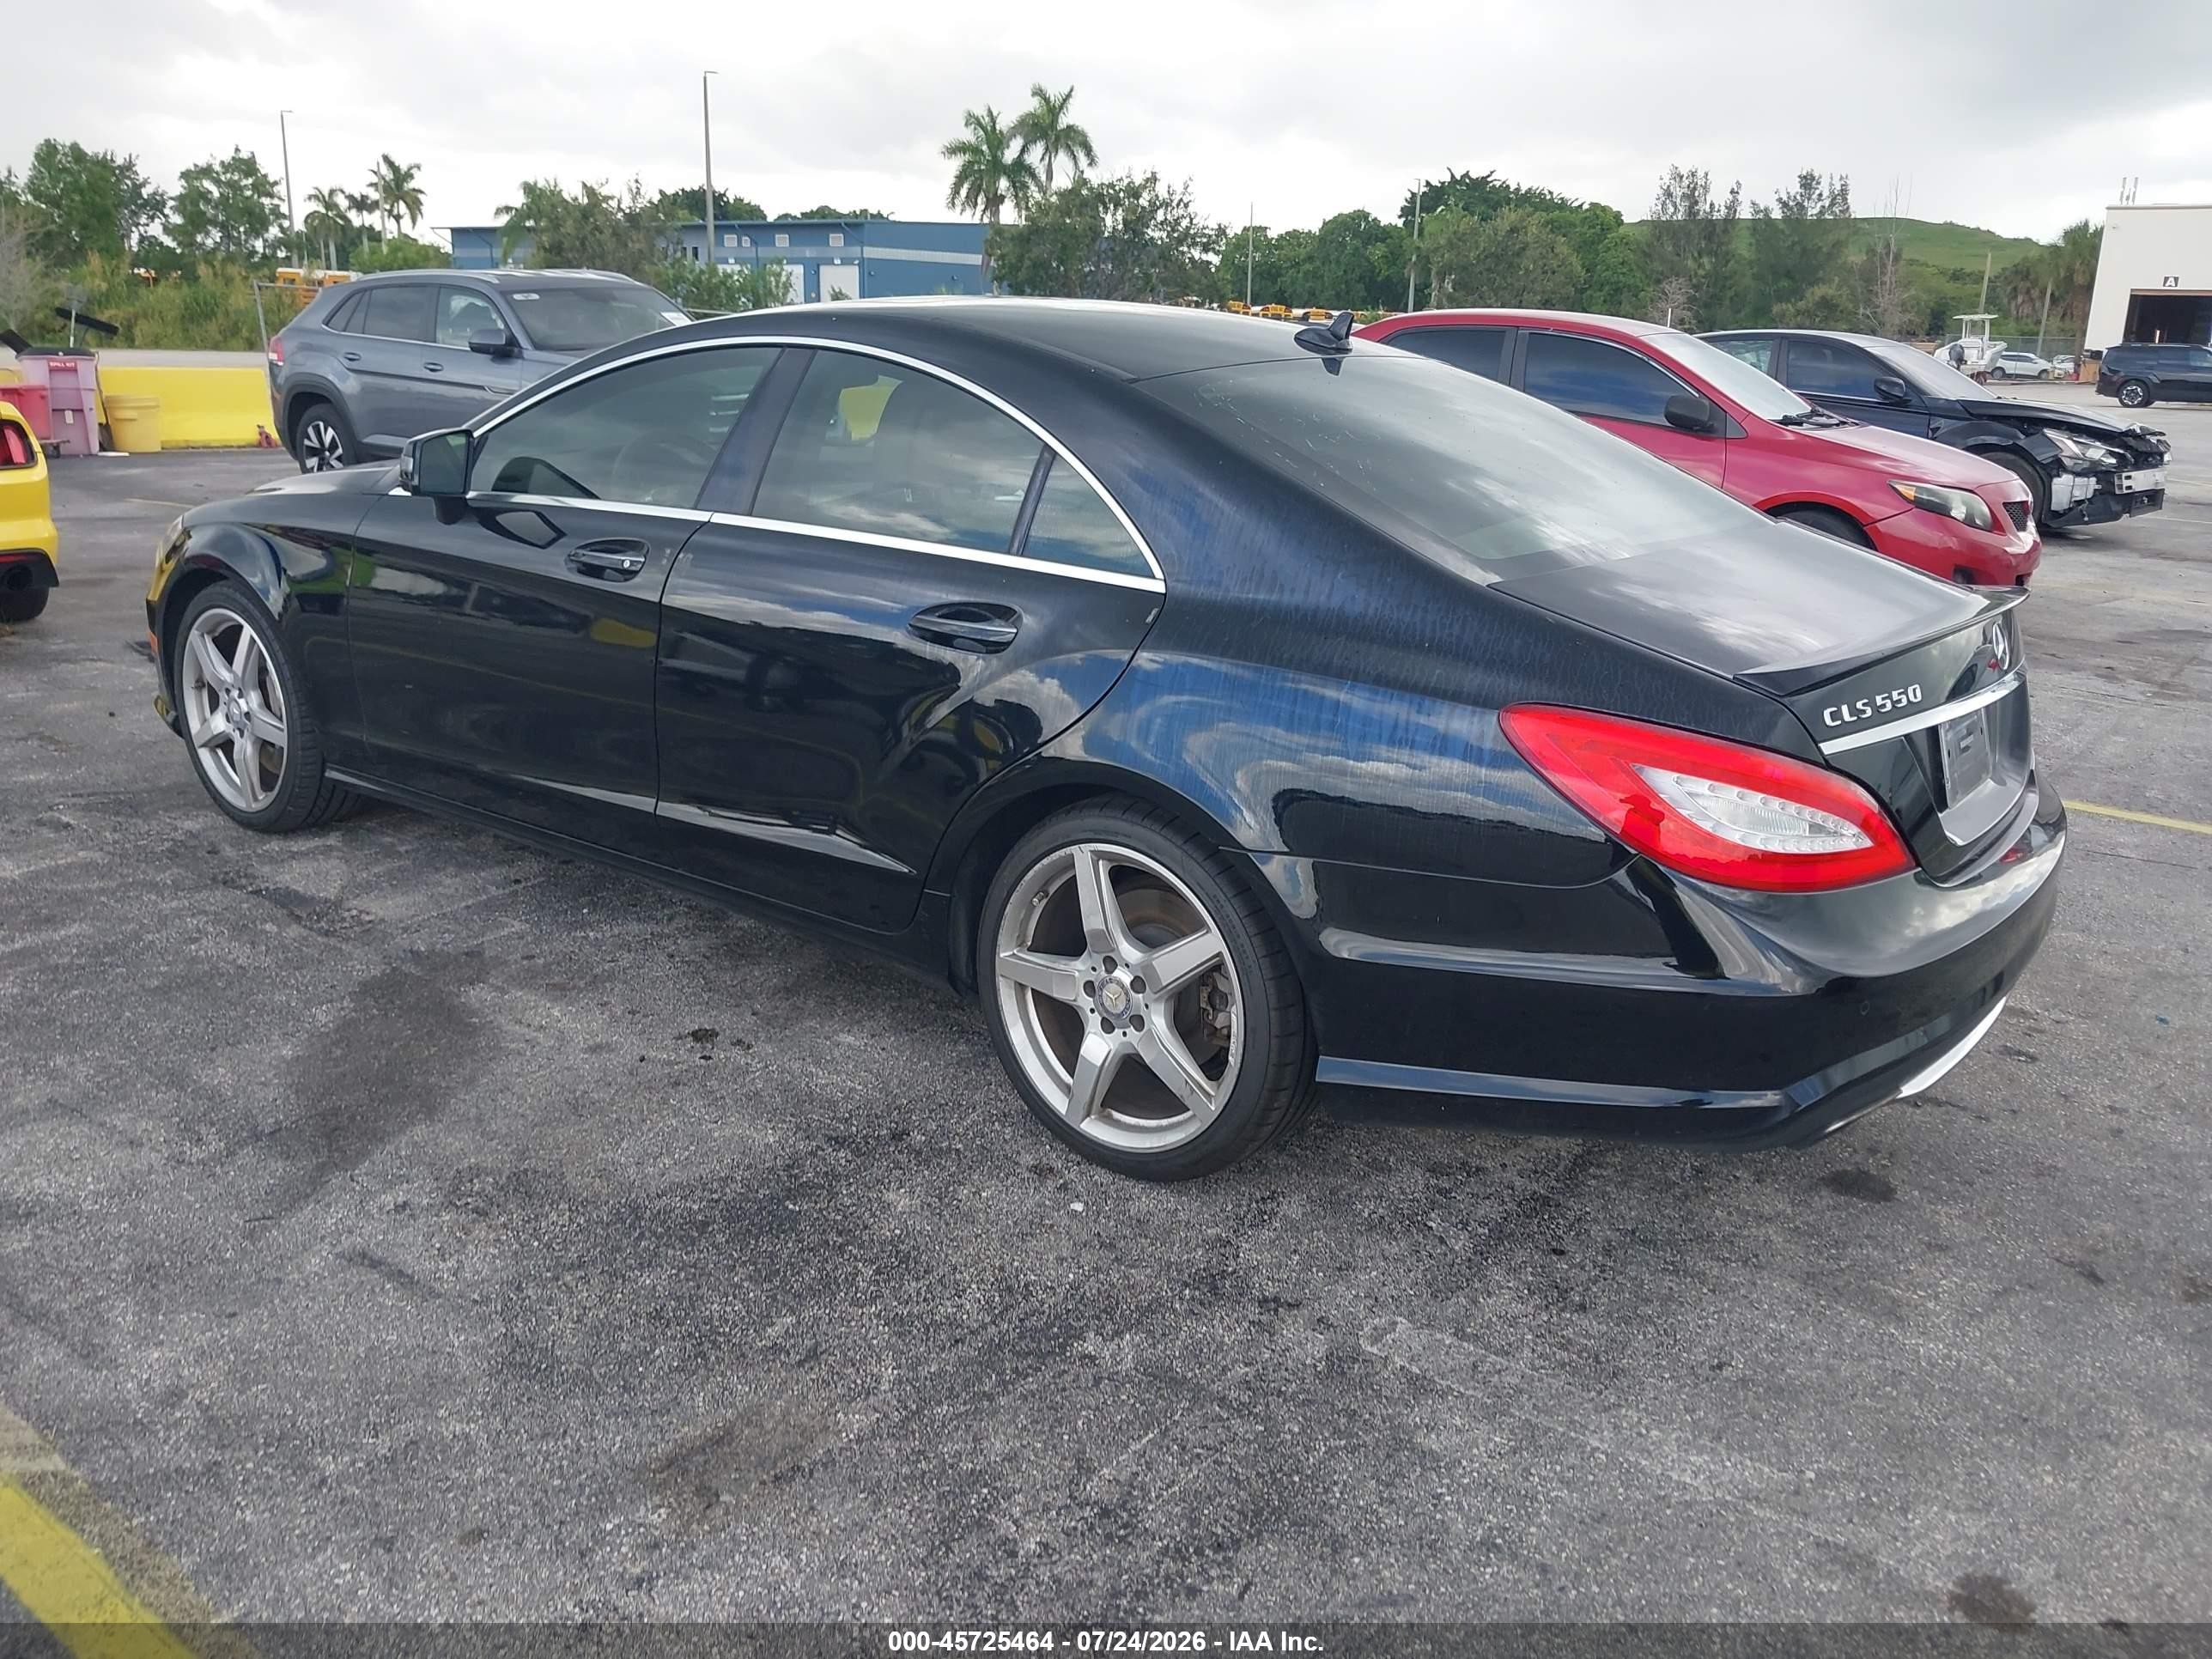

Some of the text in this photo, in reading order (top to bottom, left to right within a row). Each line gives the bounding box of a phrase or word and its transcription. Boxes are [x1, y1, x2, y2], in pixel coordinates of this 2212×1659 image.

[2165, 276, 2176, 287] A
[1823, 684, 1922, 726] CLS 550
